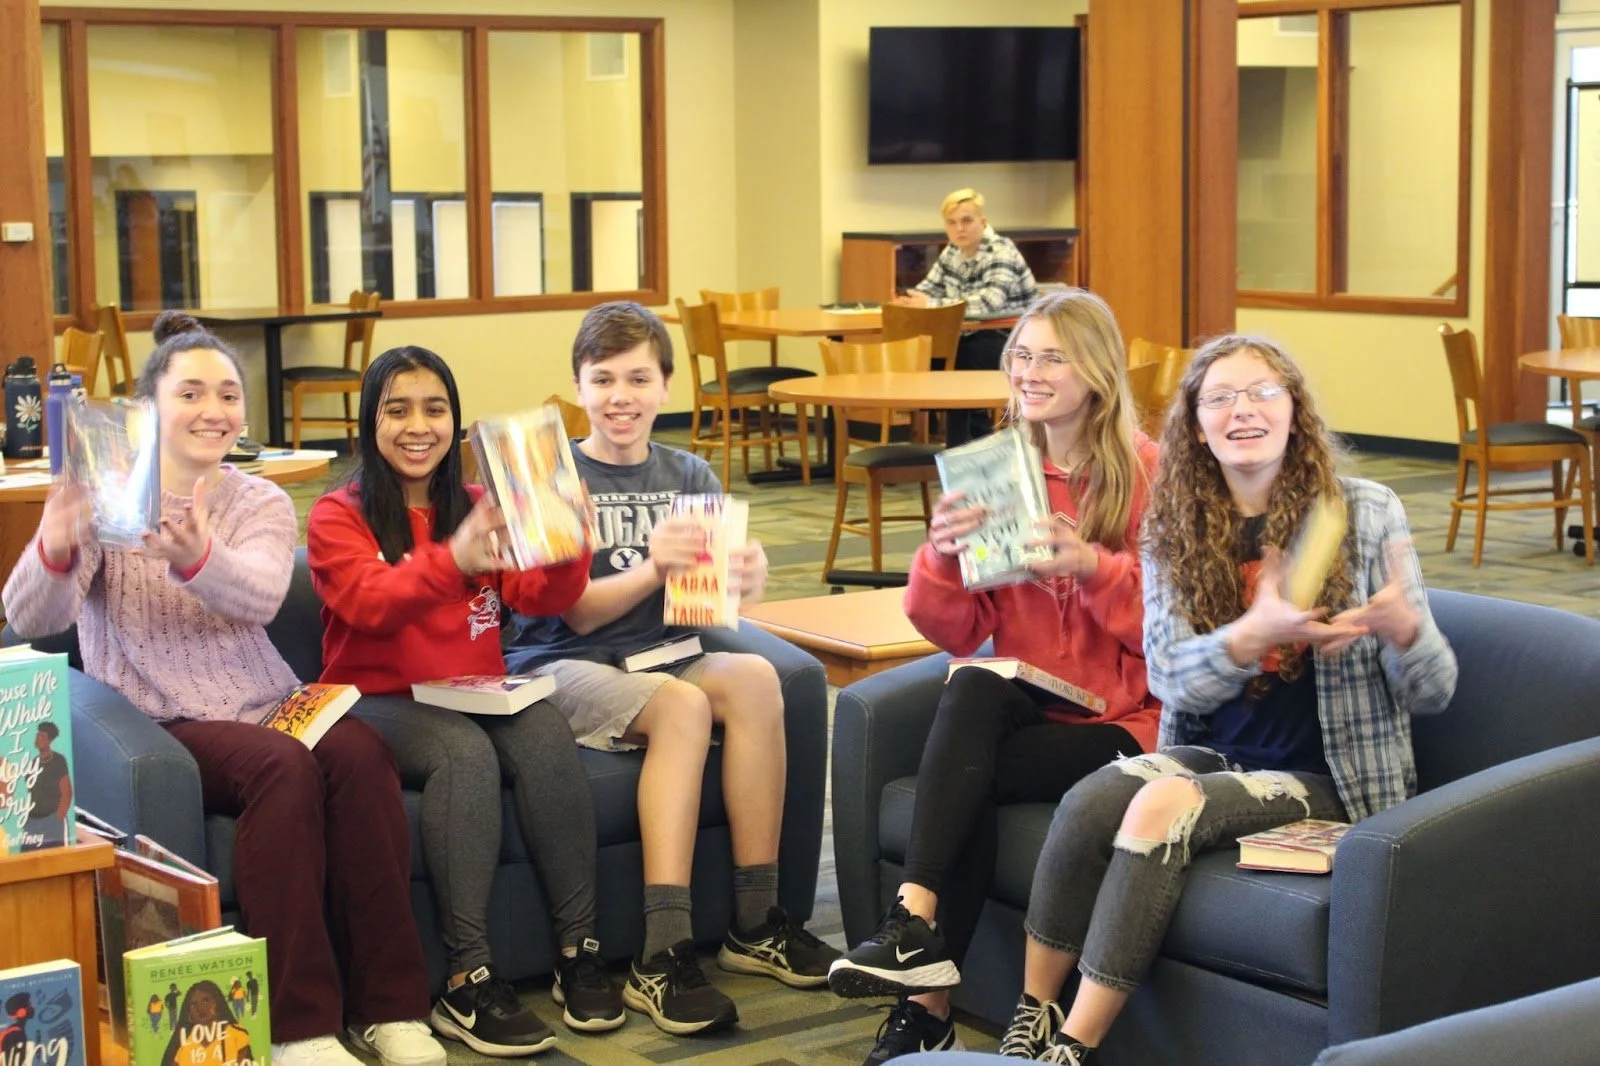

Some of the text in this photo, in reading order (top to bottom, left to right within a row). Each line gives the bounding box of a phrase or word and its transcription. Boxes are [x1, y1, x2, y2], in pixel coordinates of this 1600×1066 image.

[32, 669, 57, 697] Me
[0, 695, 53, 736] While
[9, 727, 28, 754] I
[198, 956, 253, 972] WATSON
[180, 1020, 231, 1047] LOVE
[191, 1046, 207, 1064] IS
[211, 1044, 224, 1062] A
